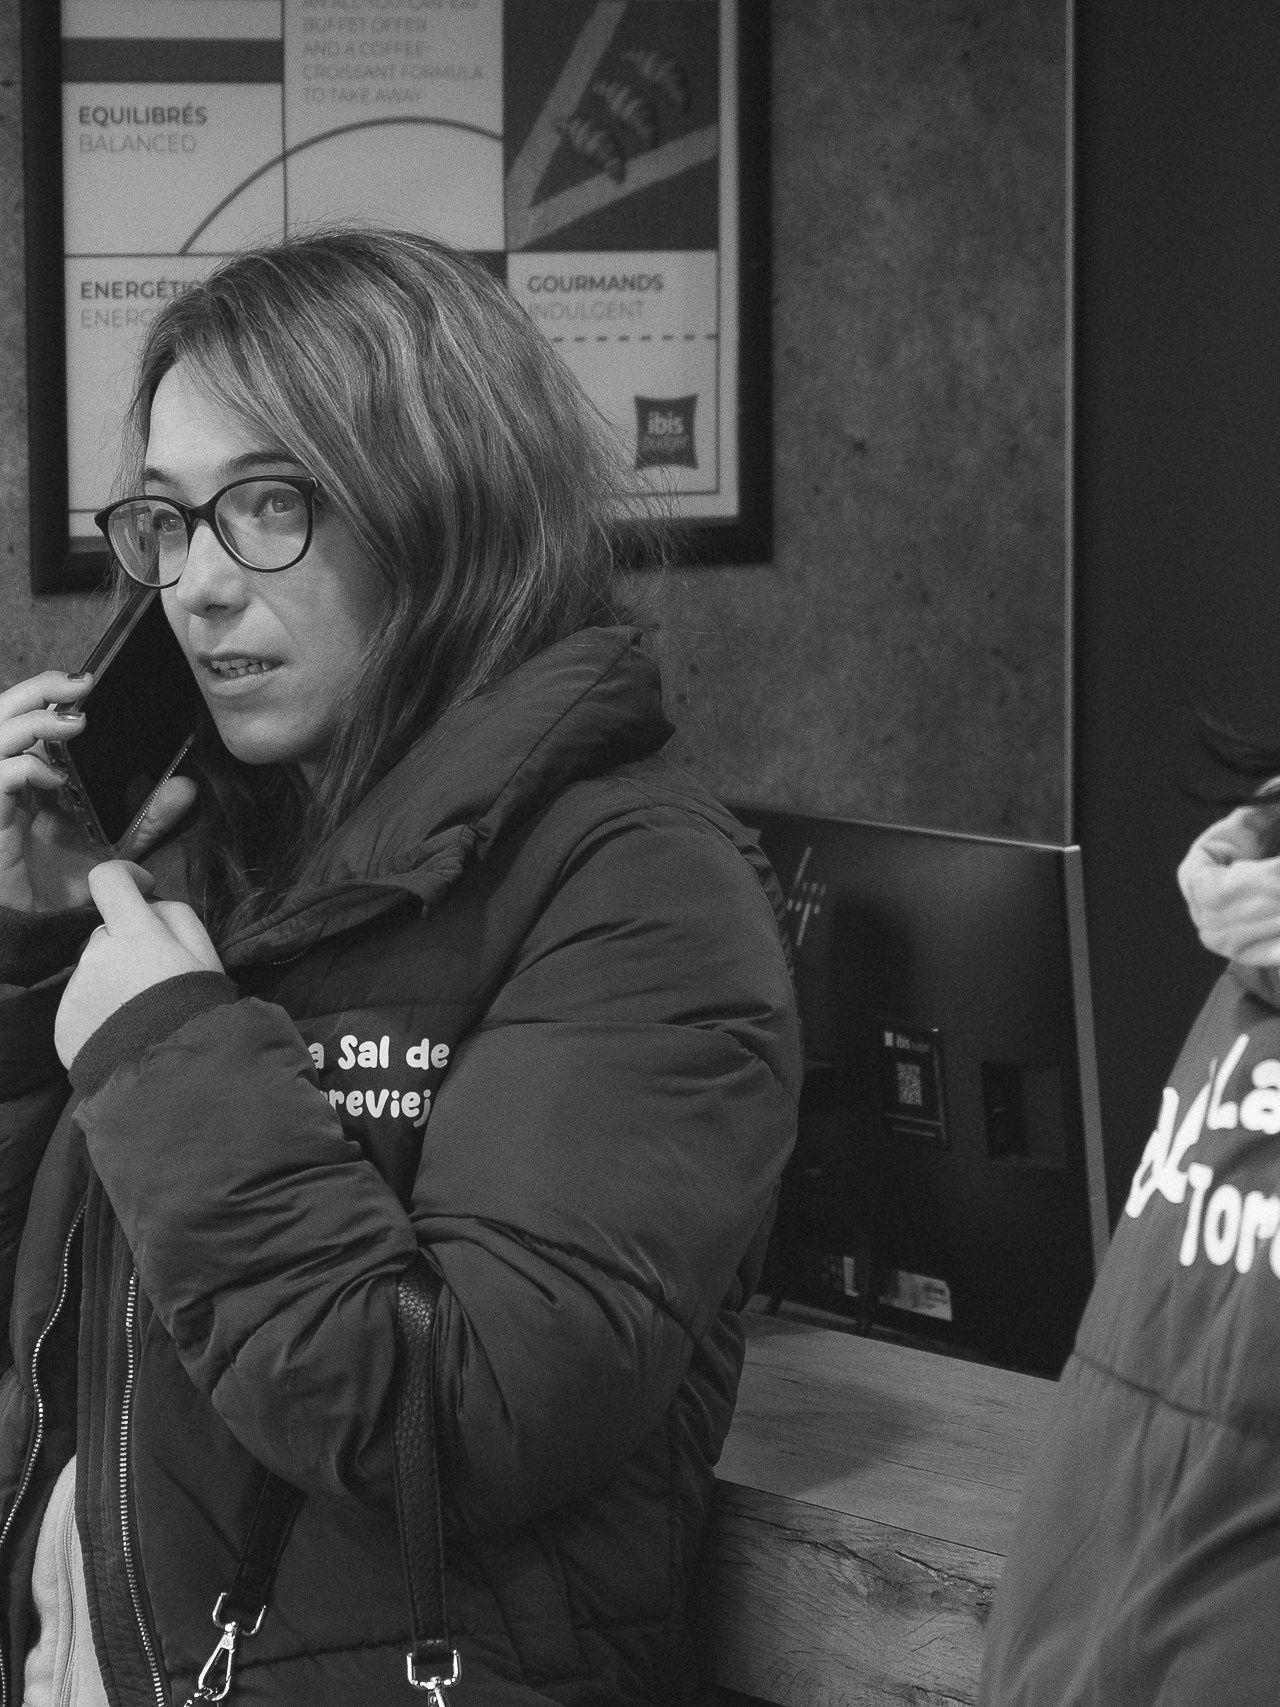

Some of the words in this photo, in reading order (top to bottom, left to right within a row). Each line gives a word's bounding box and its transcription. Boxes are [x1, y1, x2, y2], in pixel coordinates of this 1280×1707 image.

[302, 40, 341, 57] AND
[343, 40, 356, 57] A
[302, 63, 396, 81] CROISSANT
[400, 63, 486, 81] FORMULA
[302, 87, 326, 105] TO
[330, 87, 371, 105] TAKE
[78, 101, 209, 129] EQUILIBRÉS
[78, 133, 198, 154] BALANCED
[527, 272, 665, 294] GOURMANDS
[648, 411, 684, 435] ibis
[307, 1042, 324, 1070] a
[337, 1034, 391, 1070] Sal
[405, 1038, 450, 1070] de
[320, 1088, 432, 1128] reviej
[1179, 1161, 1280, 1280] Tor
